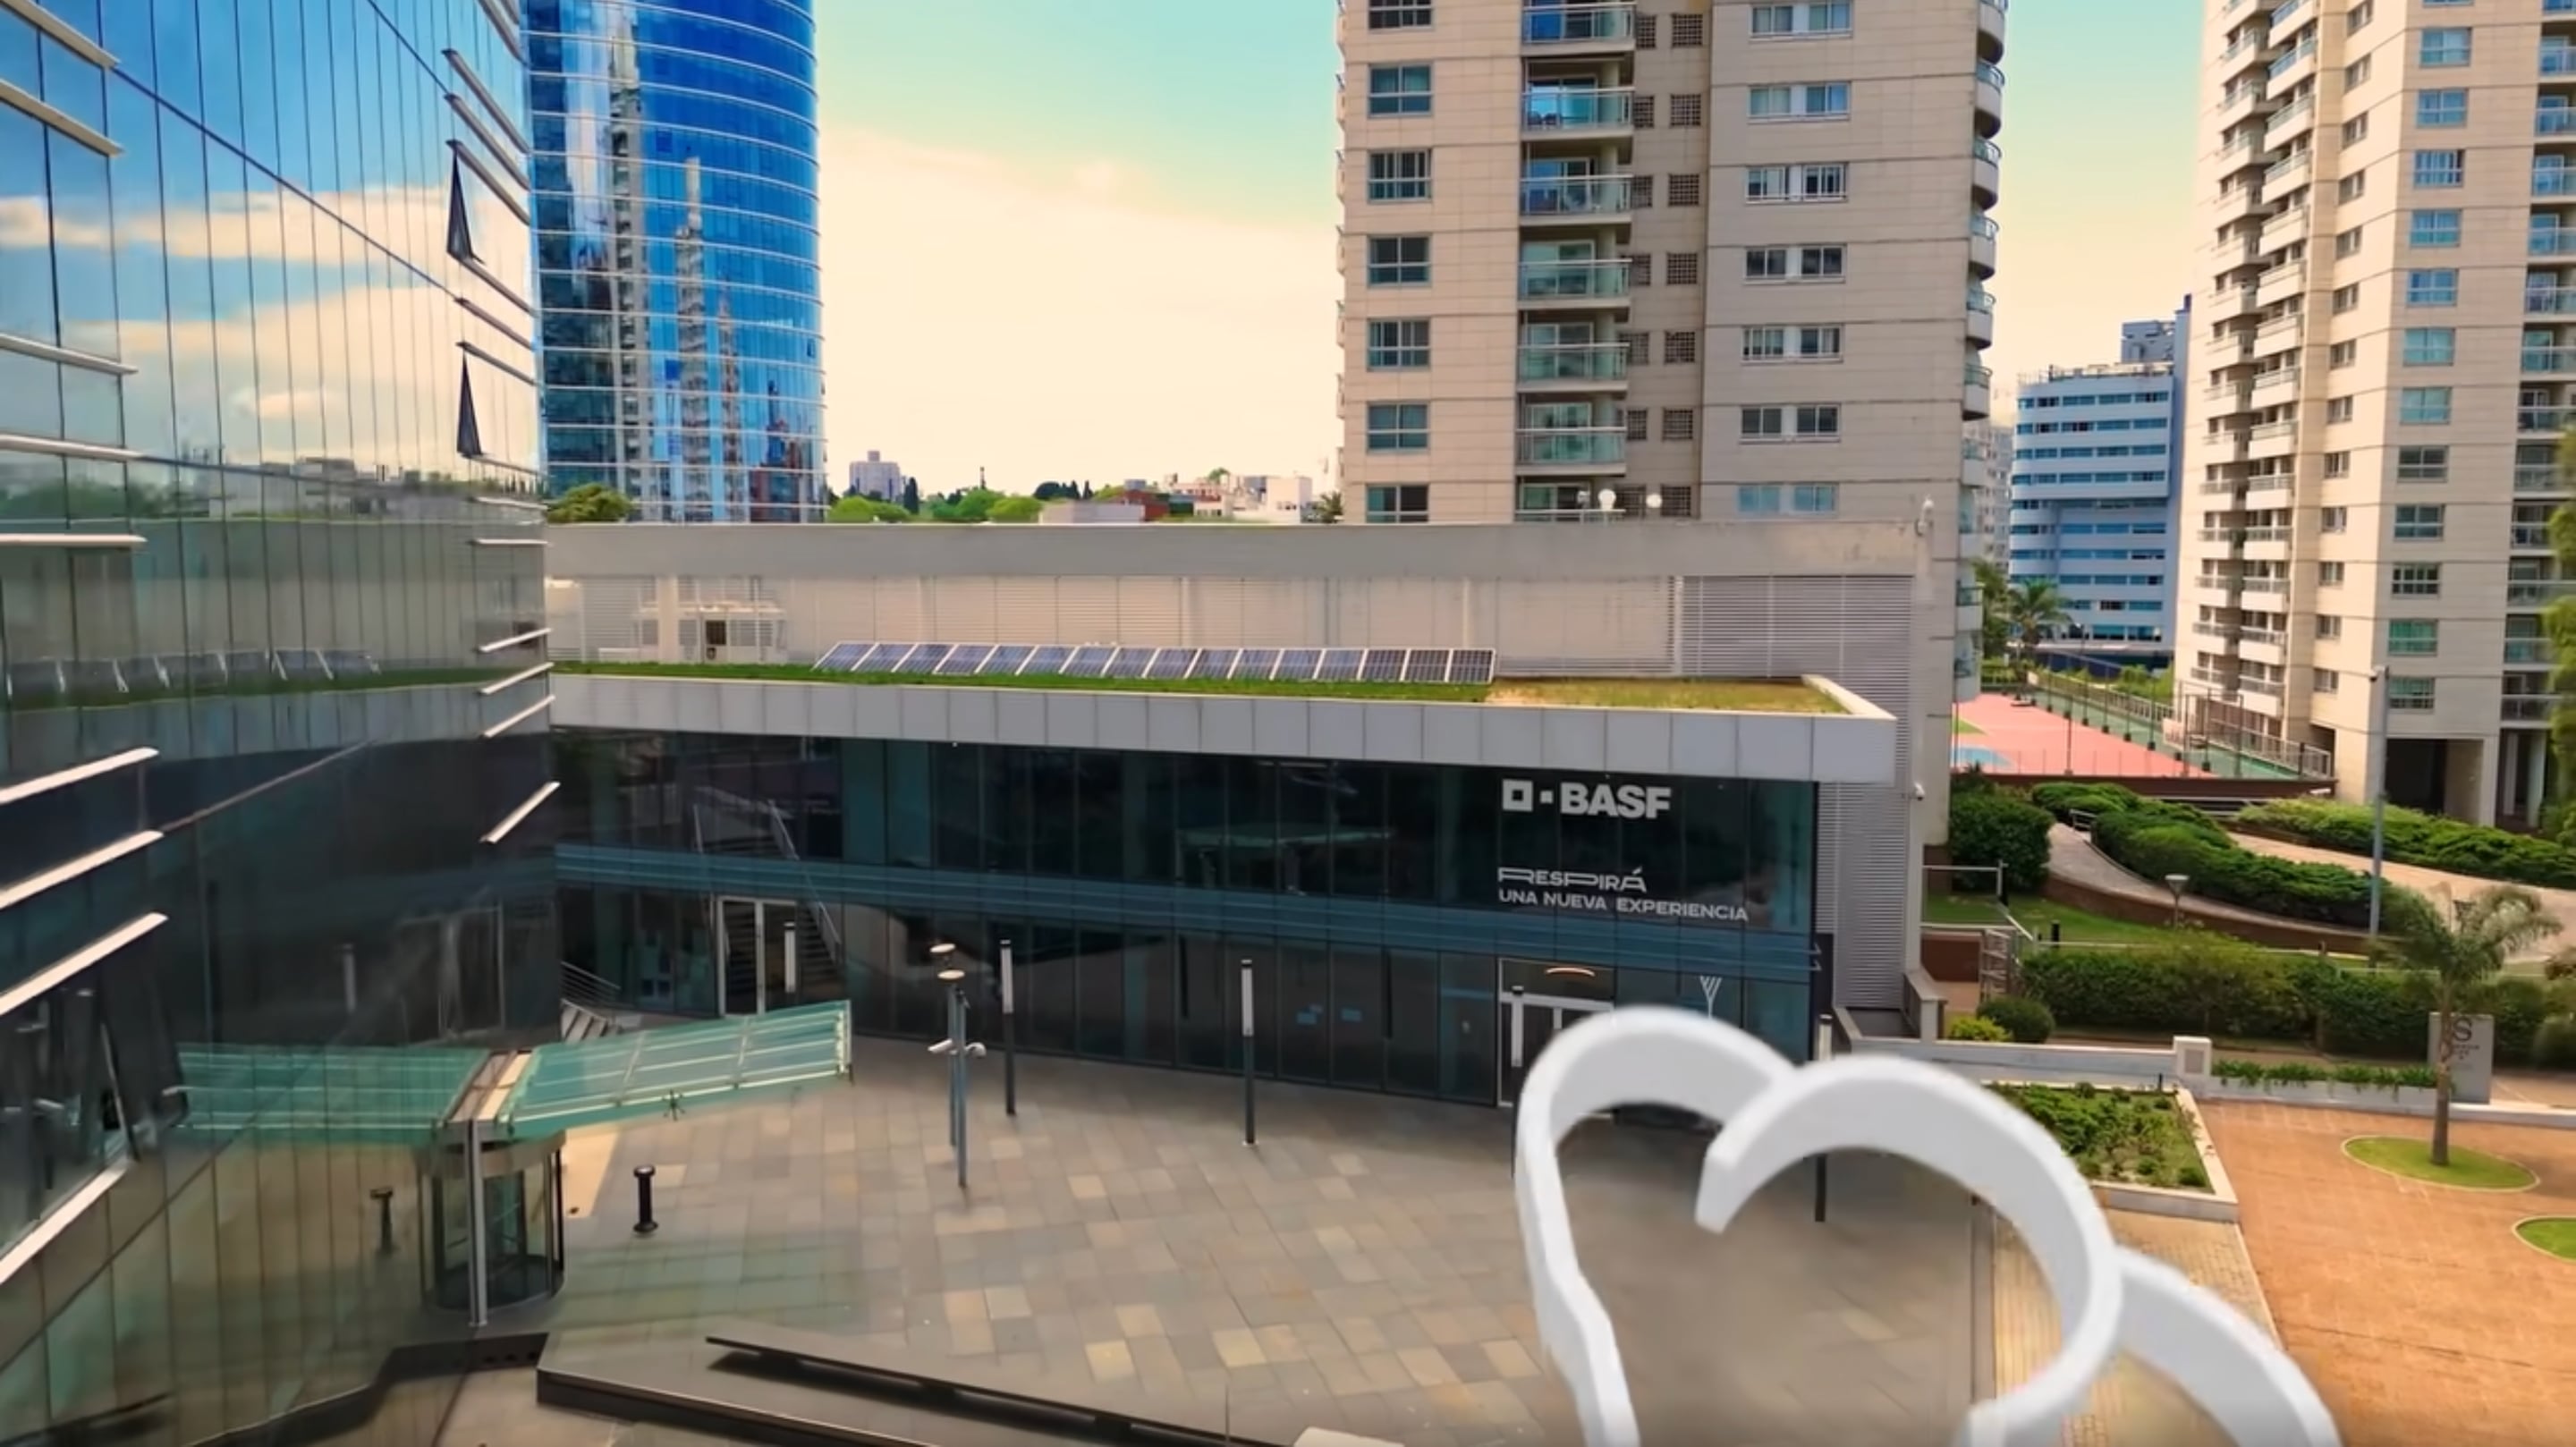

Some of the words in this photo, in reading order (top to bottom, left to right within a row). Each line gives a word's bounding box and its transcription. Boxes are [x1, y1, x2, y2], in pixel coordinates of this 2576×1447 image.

[1561, 782, 1671, 819] BASF
[1497, 867, 1647, 893] RESPIRÁ
[1499, 889, 1538, 905] UNA
[1543, 893, 1606, 910] NUEVA
[1616, 898, 1749, 921] EXPERIENCIA
